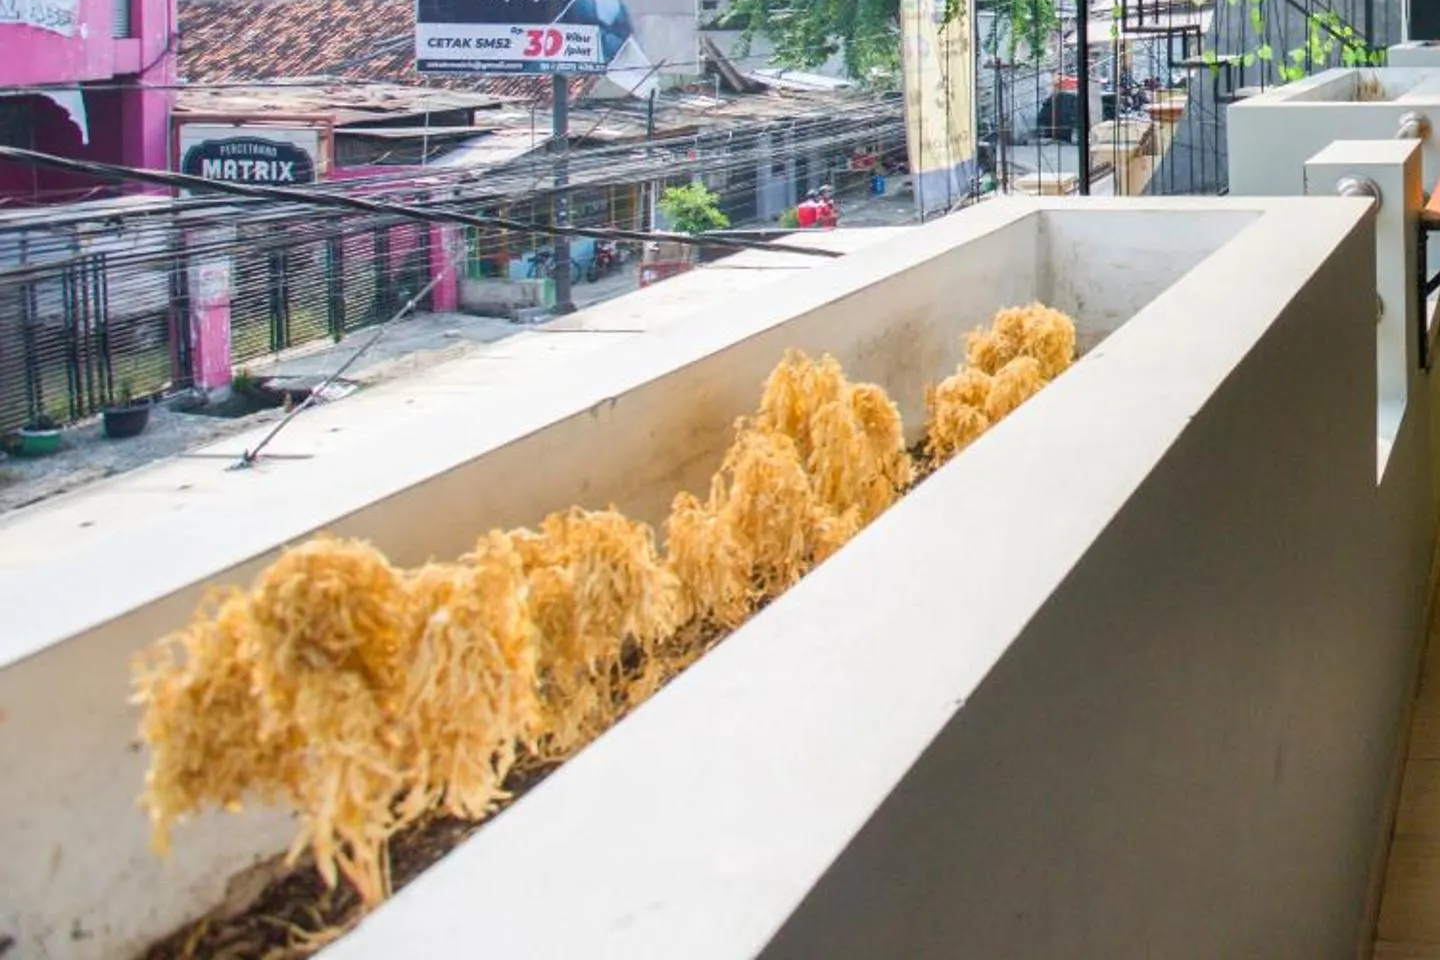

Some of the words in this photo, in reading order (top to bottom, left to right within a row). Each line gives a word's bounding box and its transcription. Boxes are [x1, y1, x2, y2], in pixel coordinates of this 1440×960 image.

[427, 37, 472, 49] CETAK
[523, 28, 564, 58] 30
[202, 159, 296, 182] MATRIX
